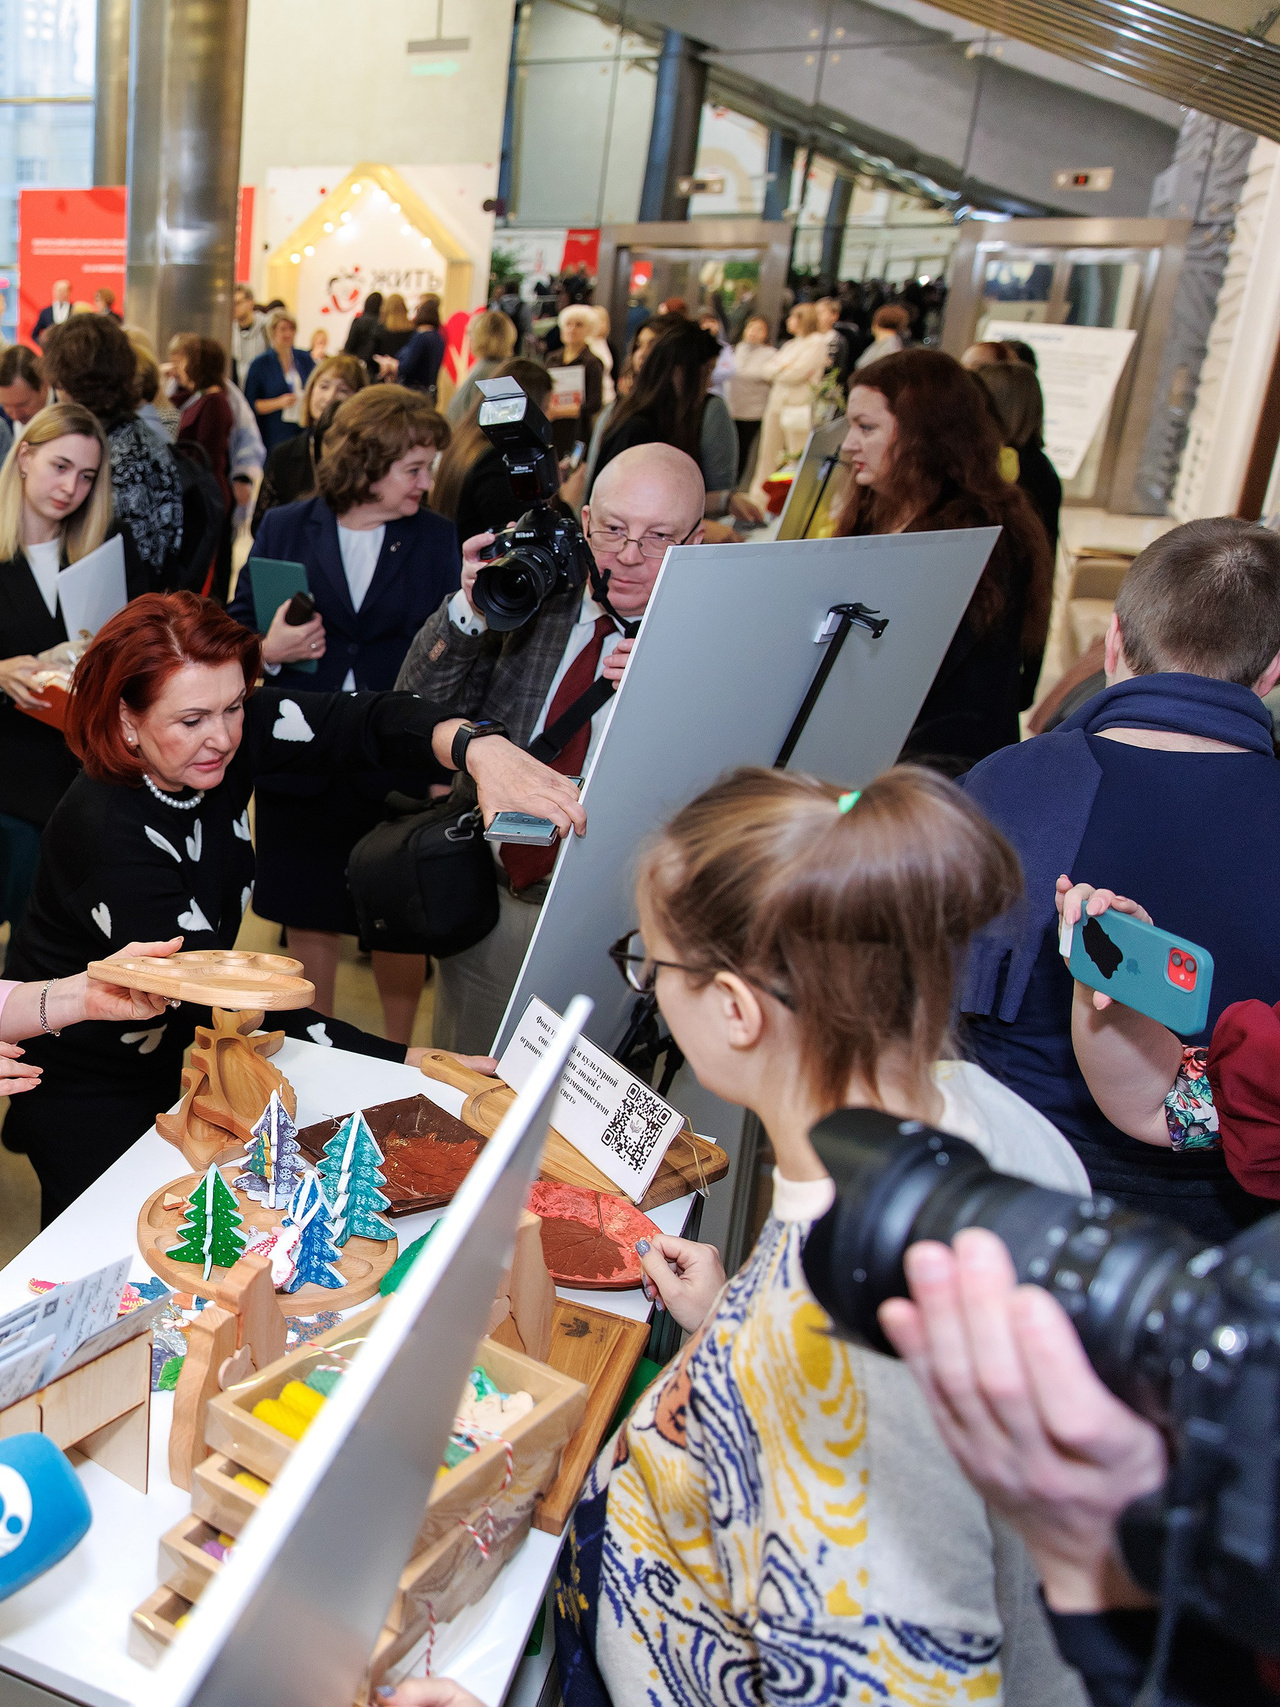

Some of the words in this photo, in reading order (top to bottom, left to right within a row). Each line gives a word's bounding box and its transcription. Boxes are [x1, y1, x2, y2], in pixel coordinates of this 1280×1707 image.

[371, 268, 442, 290] ЖИТЬ
[575, 1067, 598, 1088] людей
[596, 1084, 602, 1093] с
[581, 1054, 619, 1088] культурной
[562, 1073, 610, 1117] возможностями
